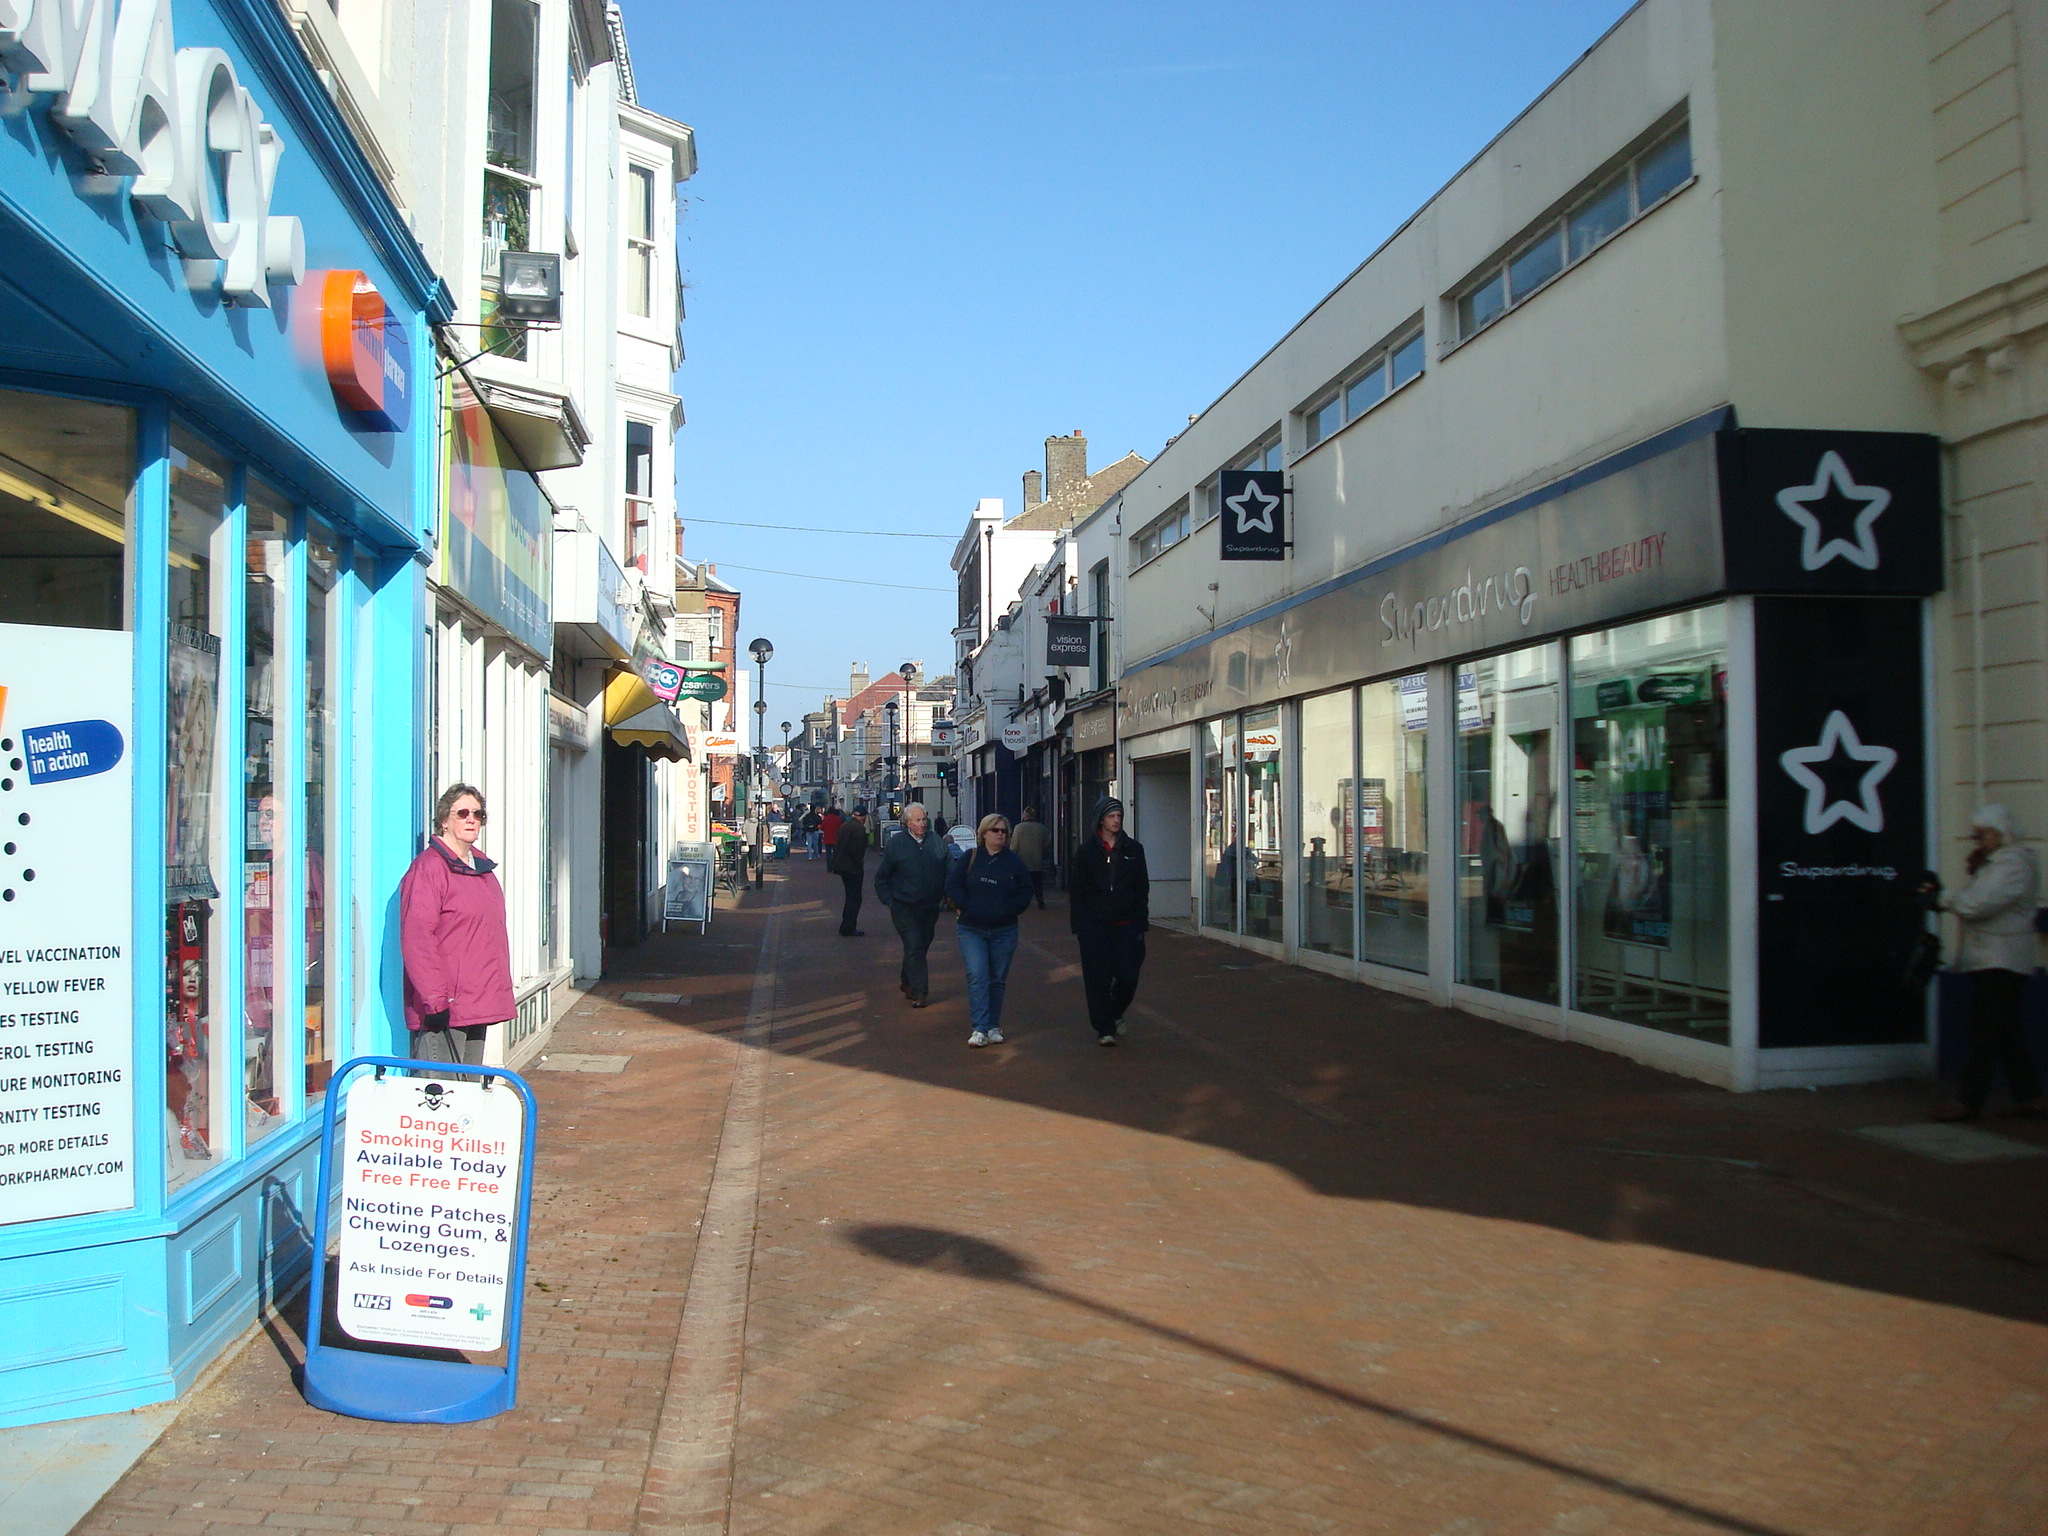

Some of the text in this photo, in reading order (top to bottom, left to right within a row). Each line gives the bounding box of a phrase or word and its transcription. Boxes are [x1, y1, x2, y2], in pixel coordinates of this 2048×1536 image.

[1225, 544, 1280, 554] Superdrug
[1379, 565, 1538, 651] Superdrug
[1051, 644, 1088, 653] express
[1056, 634, 1083, 645] vision
[28, 730, 73, 754] health
[31, 750, 90, 775] in action
[686, 725, 699, 833] WOOWORTHS
[1779, 861, 1899, 881] Superdrug
[26, 945, 121, 963] VACCINATION
[4, 977, 105, 996] YELLOW FEVER
[20, 1010, 80, 1027] TESTING
[35, 1040, 94, 1058] TESTING
[0, 1069, 122, 1092] URE MONITORING
[43, 1102, 101, 1121] TESTING
[400, 1115, 465, 1136] Dange
[19, 1139, 54, 1155] MORE
[58, 1133, 109, 1150] DETAILS
[360, 1129, 506, 1156] Smoking Kills!!
[0, 1160, 124, 1187] ORKPHARMACY.COM
[356, 1149, 507, 1179] Available Today
[361, 1169, 500, 1194] Free Free Free
[346, 1197, 513, 1228] Nicotine Patches,
[349, 1215, 509, 1243] Chewing Gum, &
[378, 1236, 477, 1259] Lozenges.
[349, 1261, 505, 1286] Ask Inside For Details
[354, 1293, 391, 1311] NHS
